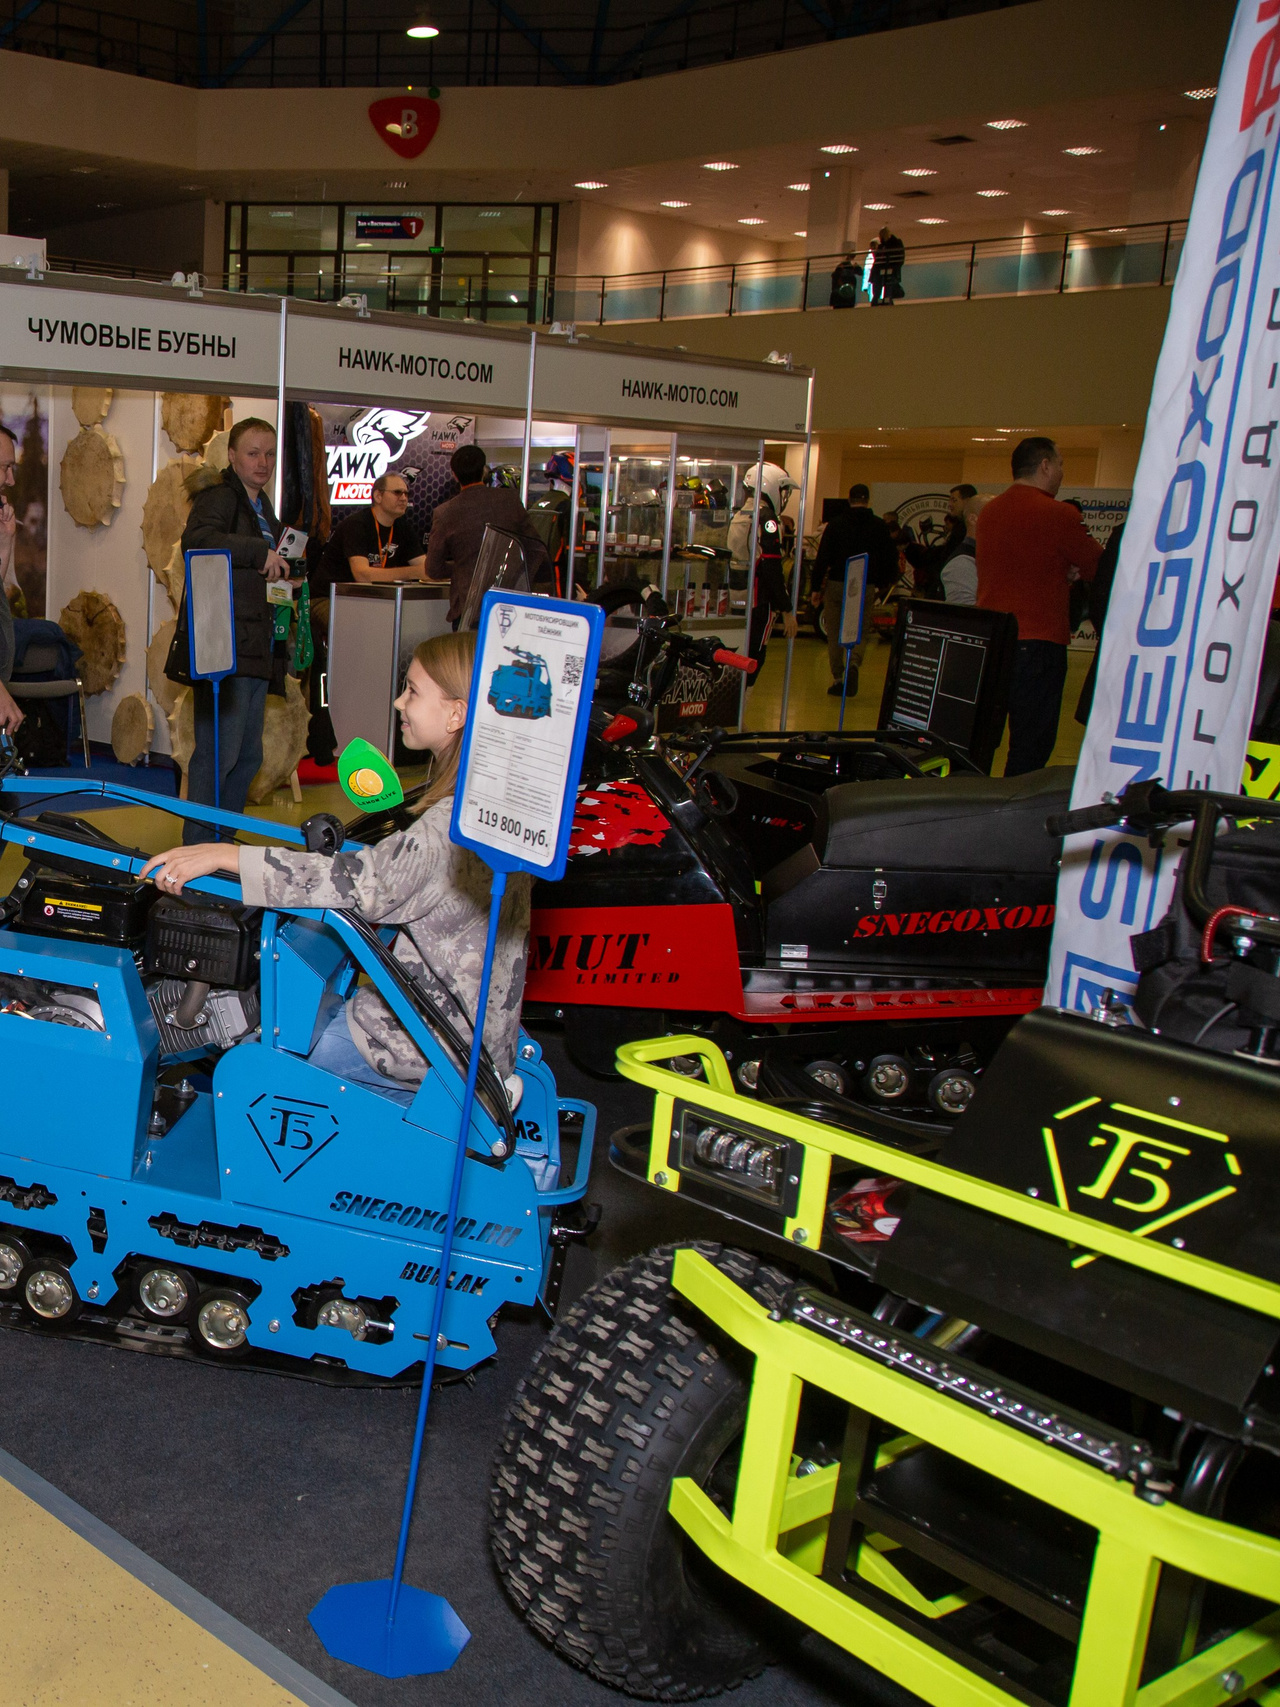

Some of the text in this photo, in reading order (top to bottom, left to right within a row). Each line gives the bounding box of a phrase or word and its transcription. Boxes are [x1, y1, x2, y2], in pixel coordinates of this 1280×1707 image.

[409, 221, 417, 234] 1
[28, 317, 236, 358] ЧУМОВЫЕ БУБНЫ
[339, 347, 493, 383] HAWK-MOTO.COM
[622, 379, 738, 408] HAWK-MOTO.COM
[431, 430, 456, 442] HAWK
[327, 452, 381, 479] AWK
[339, 484, 372, 499] MOTO
[681, 704, 704, 715] MOTO
[478, 808, 549, 848] 119 800 руб.
[576, 972, 680, 985] LIMITED
